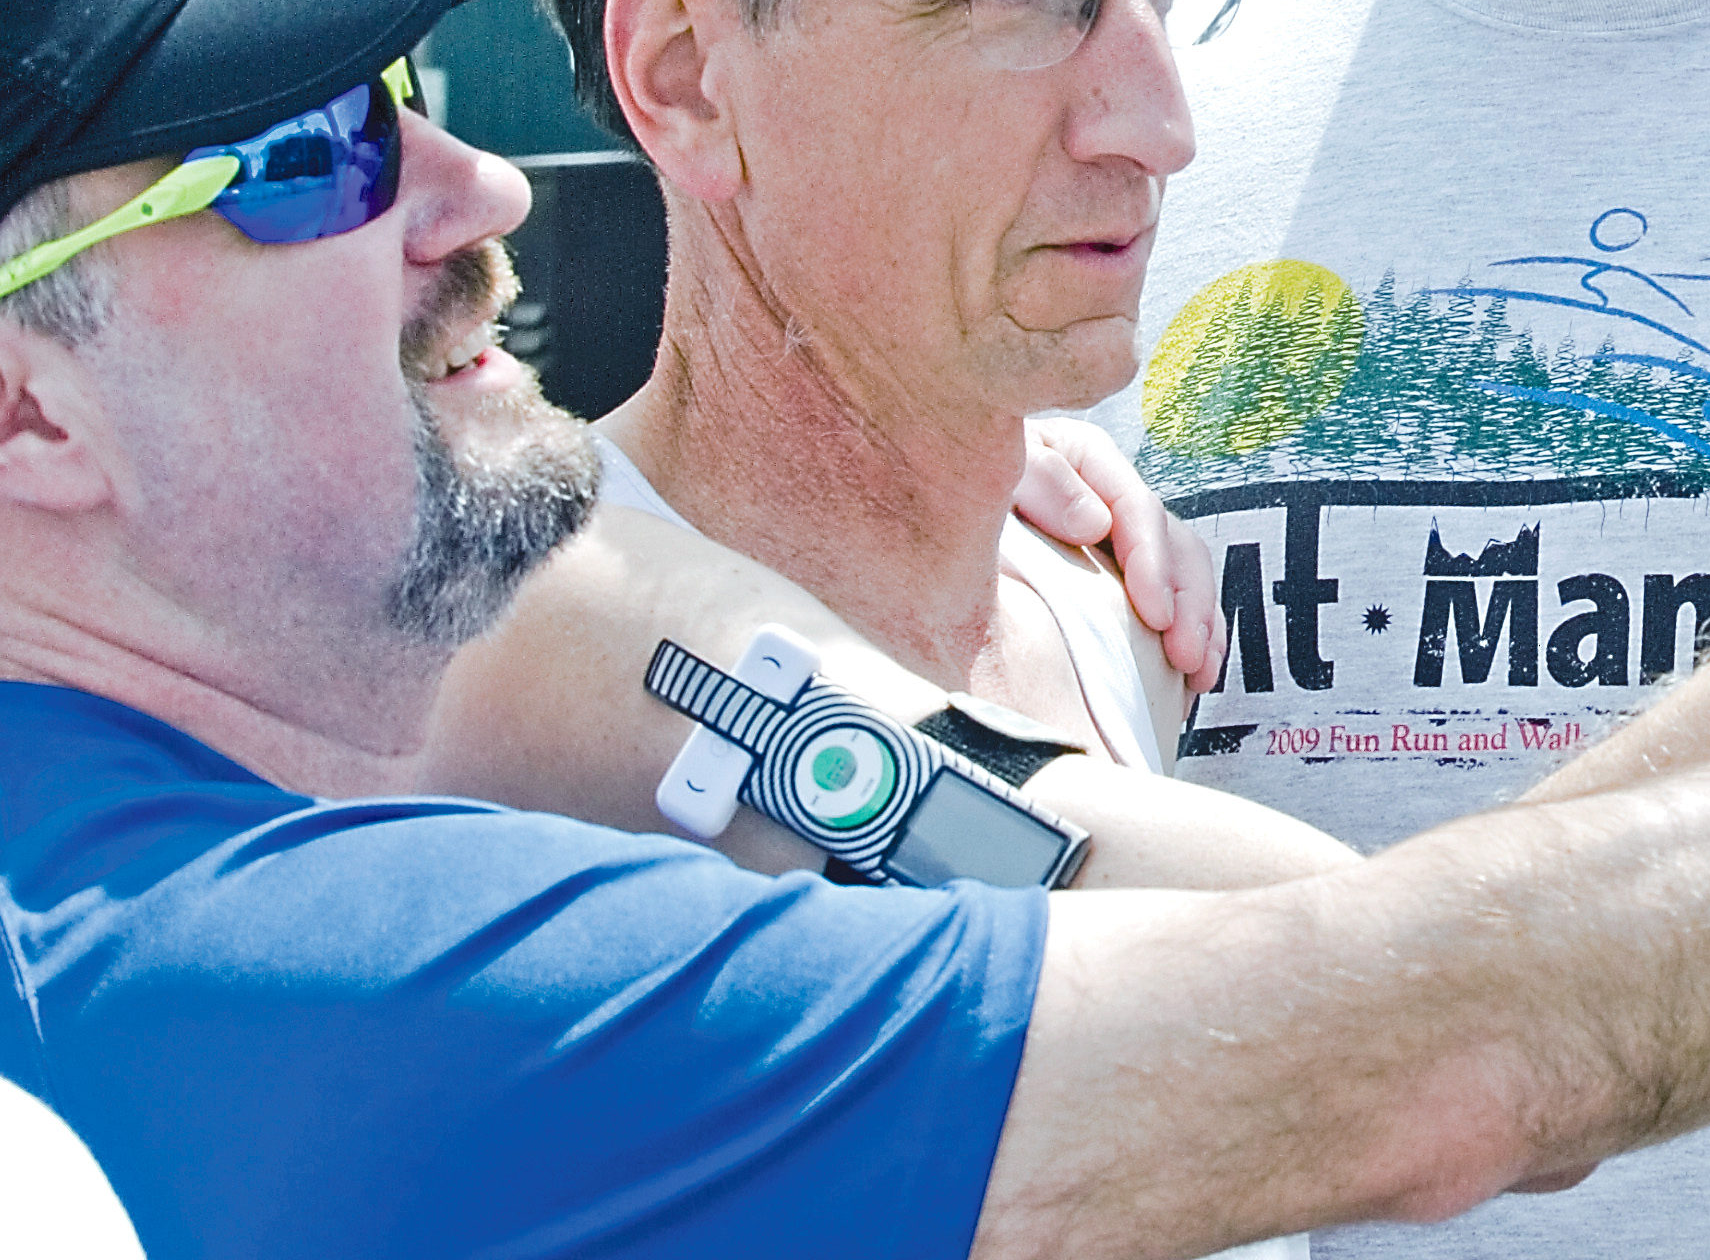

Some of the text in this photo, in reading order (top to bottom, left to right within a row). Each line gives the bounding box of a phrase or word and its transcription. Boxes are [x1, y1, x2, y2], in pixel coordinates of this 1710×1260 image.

[1265, 727, 1320, 755] 2009
[1328, 725, 1380, 753] Fun
[1391, 724, 1449, 752] Run
[1457, 722, 1508, 752] and
